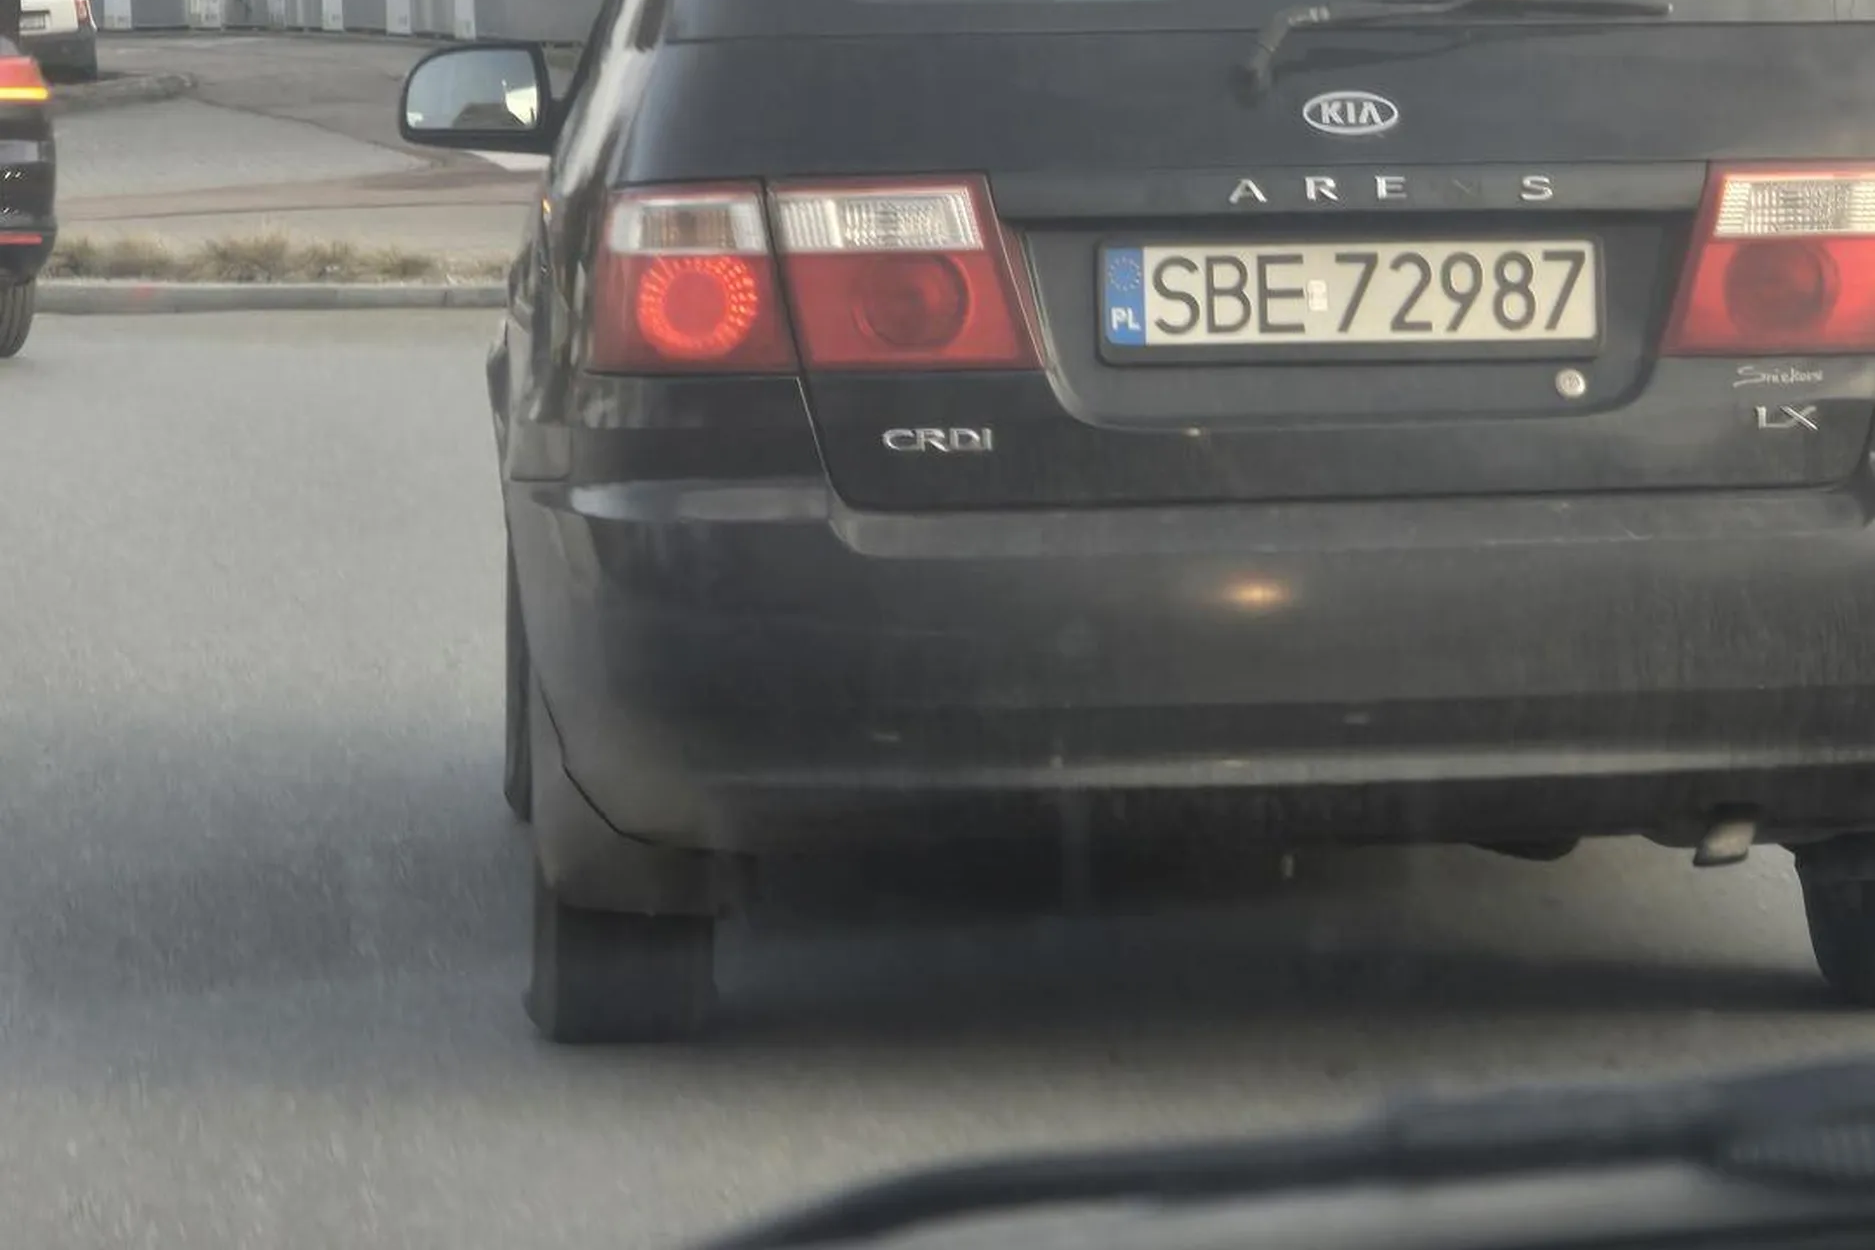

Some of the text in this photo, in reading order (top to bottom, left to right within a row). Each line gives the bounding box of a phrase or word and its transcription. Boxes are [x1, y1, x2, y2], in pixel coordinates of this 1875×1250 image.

[1319, 100, 1385, 127] KIA
[1151, 250, 1587, 335] SBE 72987
[1110, 307, 1141, 331] PL
[1755, 405, 1819, 431] LX
